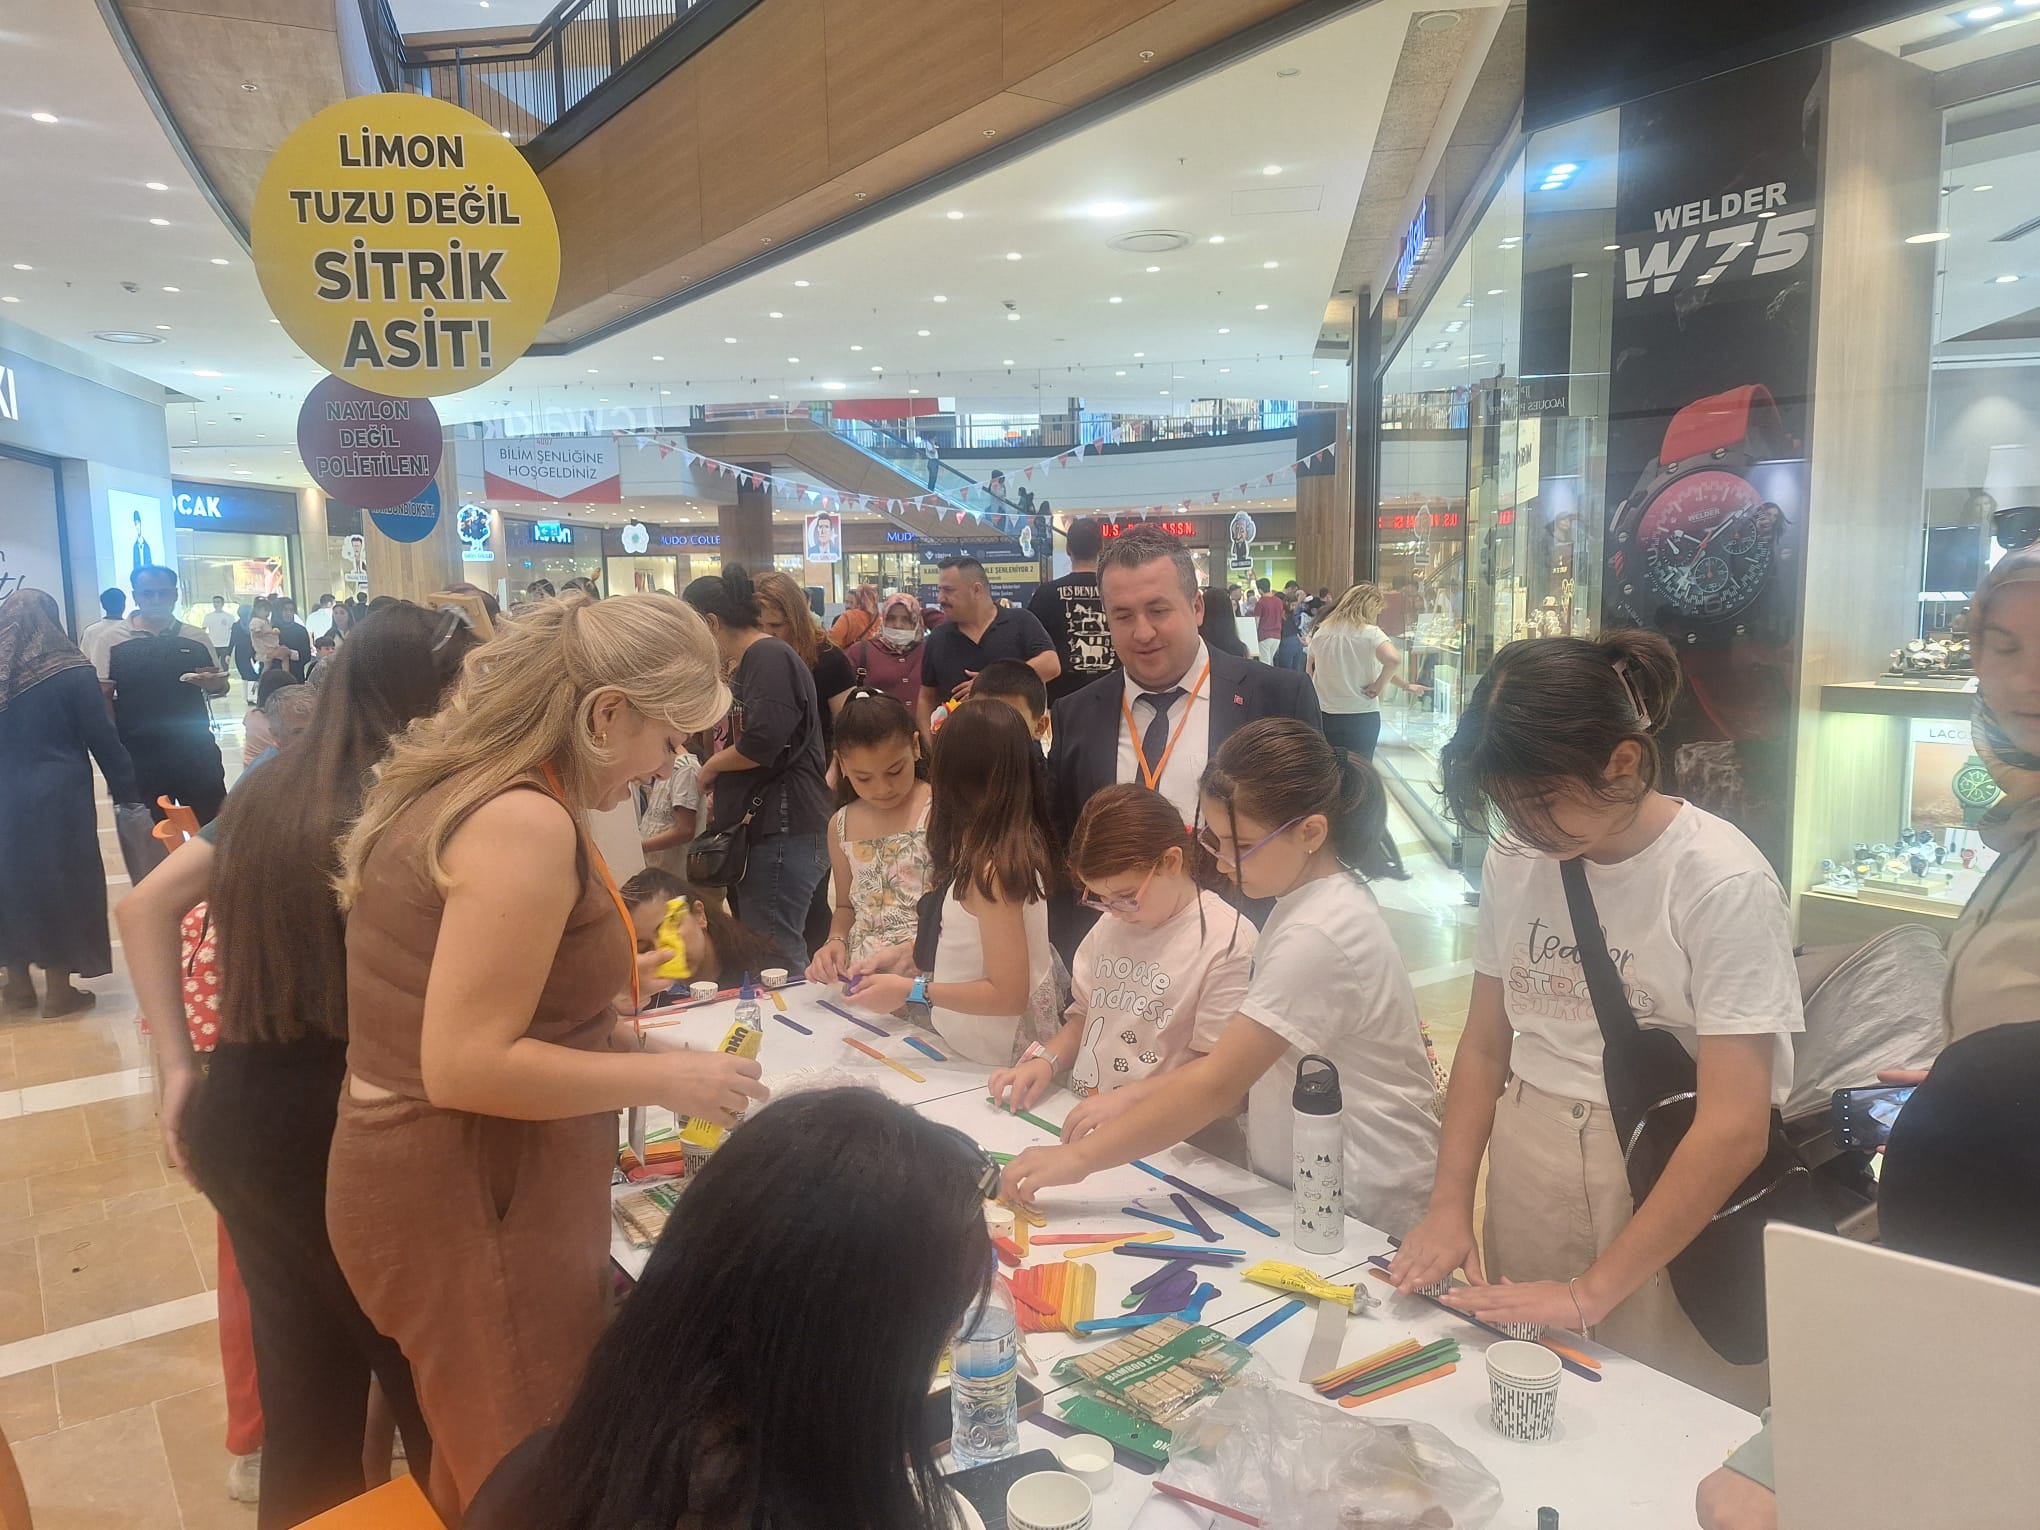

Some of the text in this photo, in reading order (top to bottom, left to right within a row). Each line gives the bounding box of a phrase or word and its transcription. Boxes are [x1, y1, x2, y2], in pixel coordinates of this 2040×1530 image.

[338, 126, 464, 168] LİMON
[289, 184, 521, 225] TUZU DEĞİL
[1654, 182, 1788, 233] WELDER
[313, 238, 508, 301] SİTRİK
[343, 307, 492, 369] ASİT!
[326, 400, 410, 421] NAYLON
[339, 424, 400, 449] DEĞİL
[316, 452, 430, 478] POLİETİLEN!
[499, 446, 604, 465] BİLİM ŞENLİĞİNE
[508, 464, 597, 481] HOŞGELDİNİZ
[887, 531, 915, 542] MUD
[1102, 523, 1121, 538] U.S.
[1104, 1358, 1147, 1382] BAMBOO
[1143, 1352, 1164, 1366] PEG
